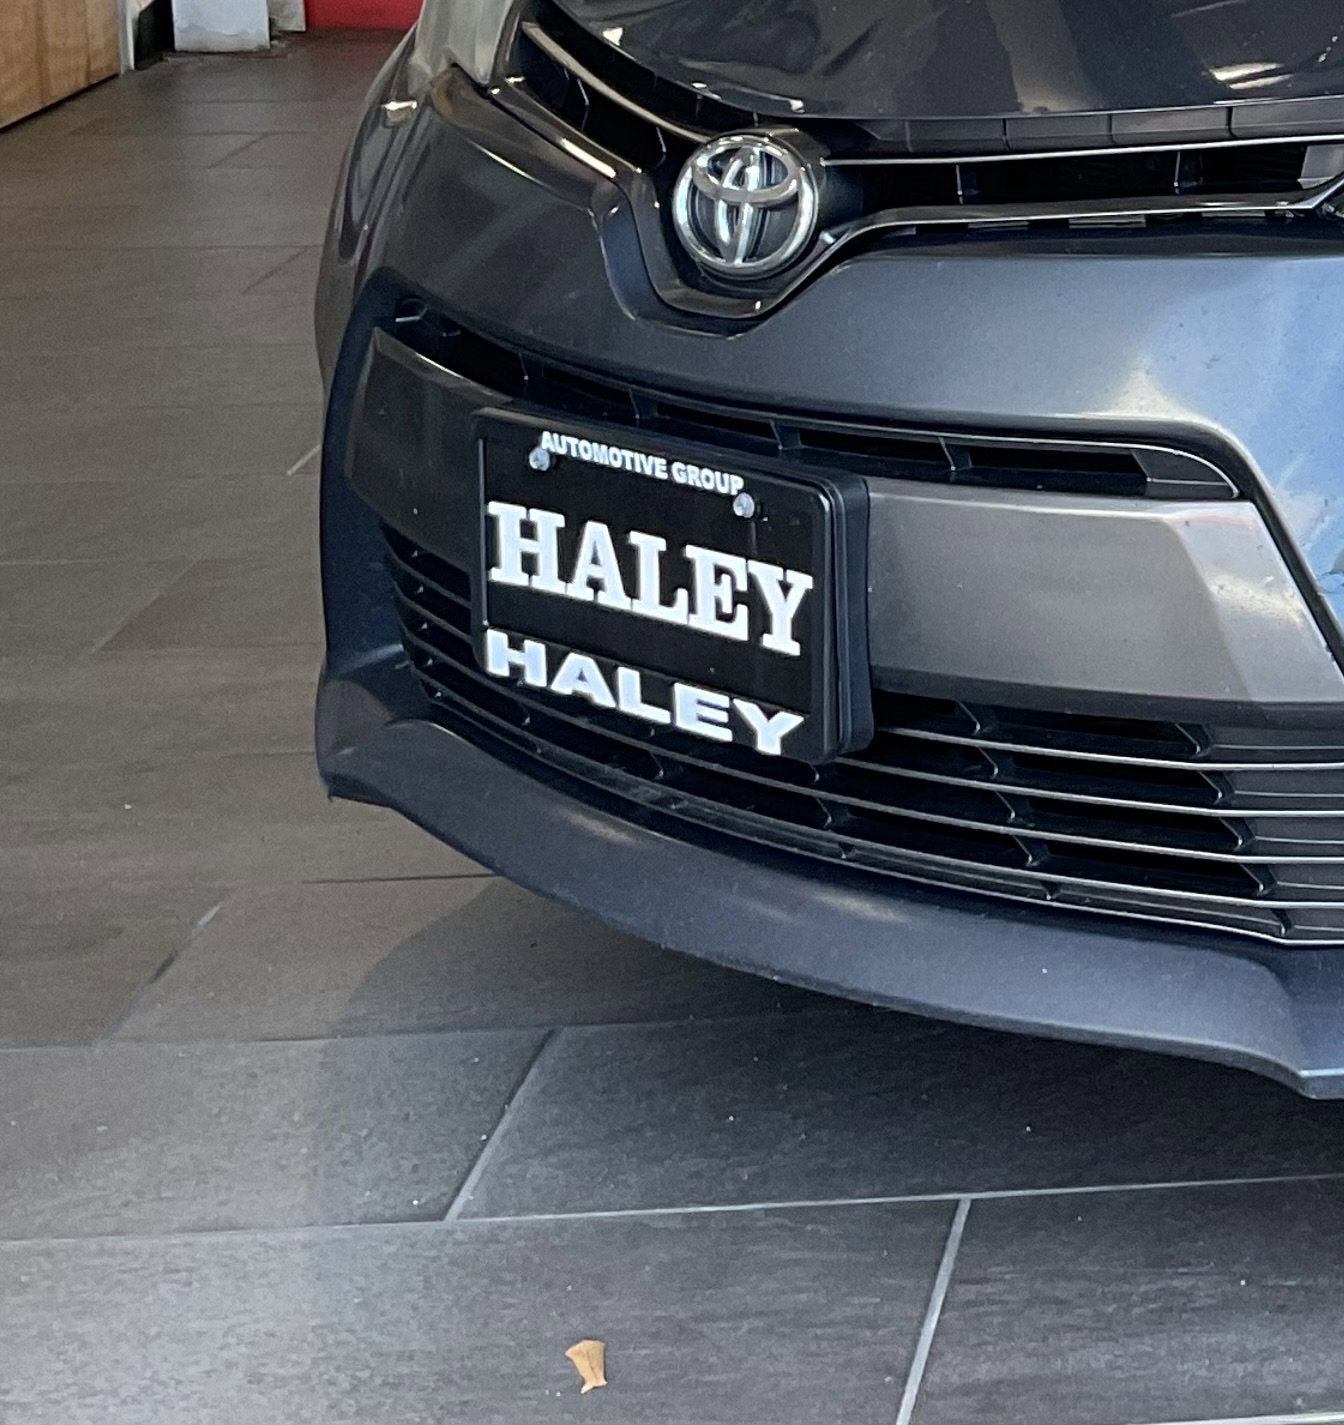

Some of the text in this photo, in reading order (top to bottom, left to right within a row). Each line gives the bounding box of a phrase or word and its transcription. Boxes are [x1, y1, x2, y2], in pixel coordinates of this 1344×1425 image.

[541, 431, 744, 495] AUTOMOTIVE GROUP
[487, 501, 813, 656] HALEY
[486, 629, 805, 756] HALEY
